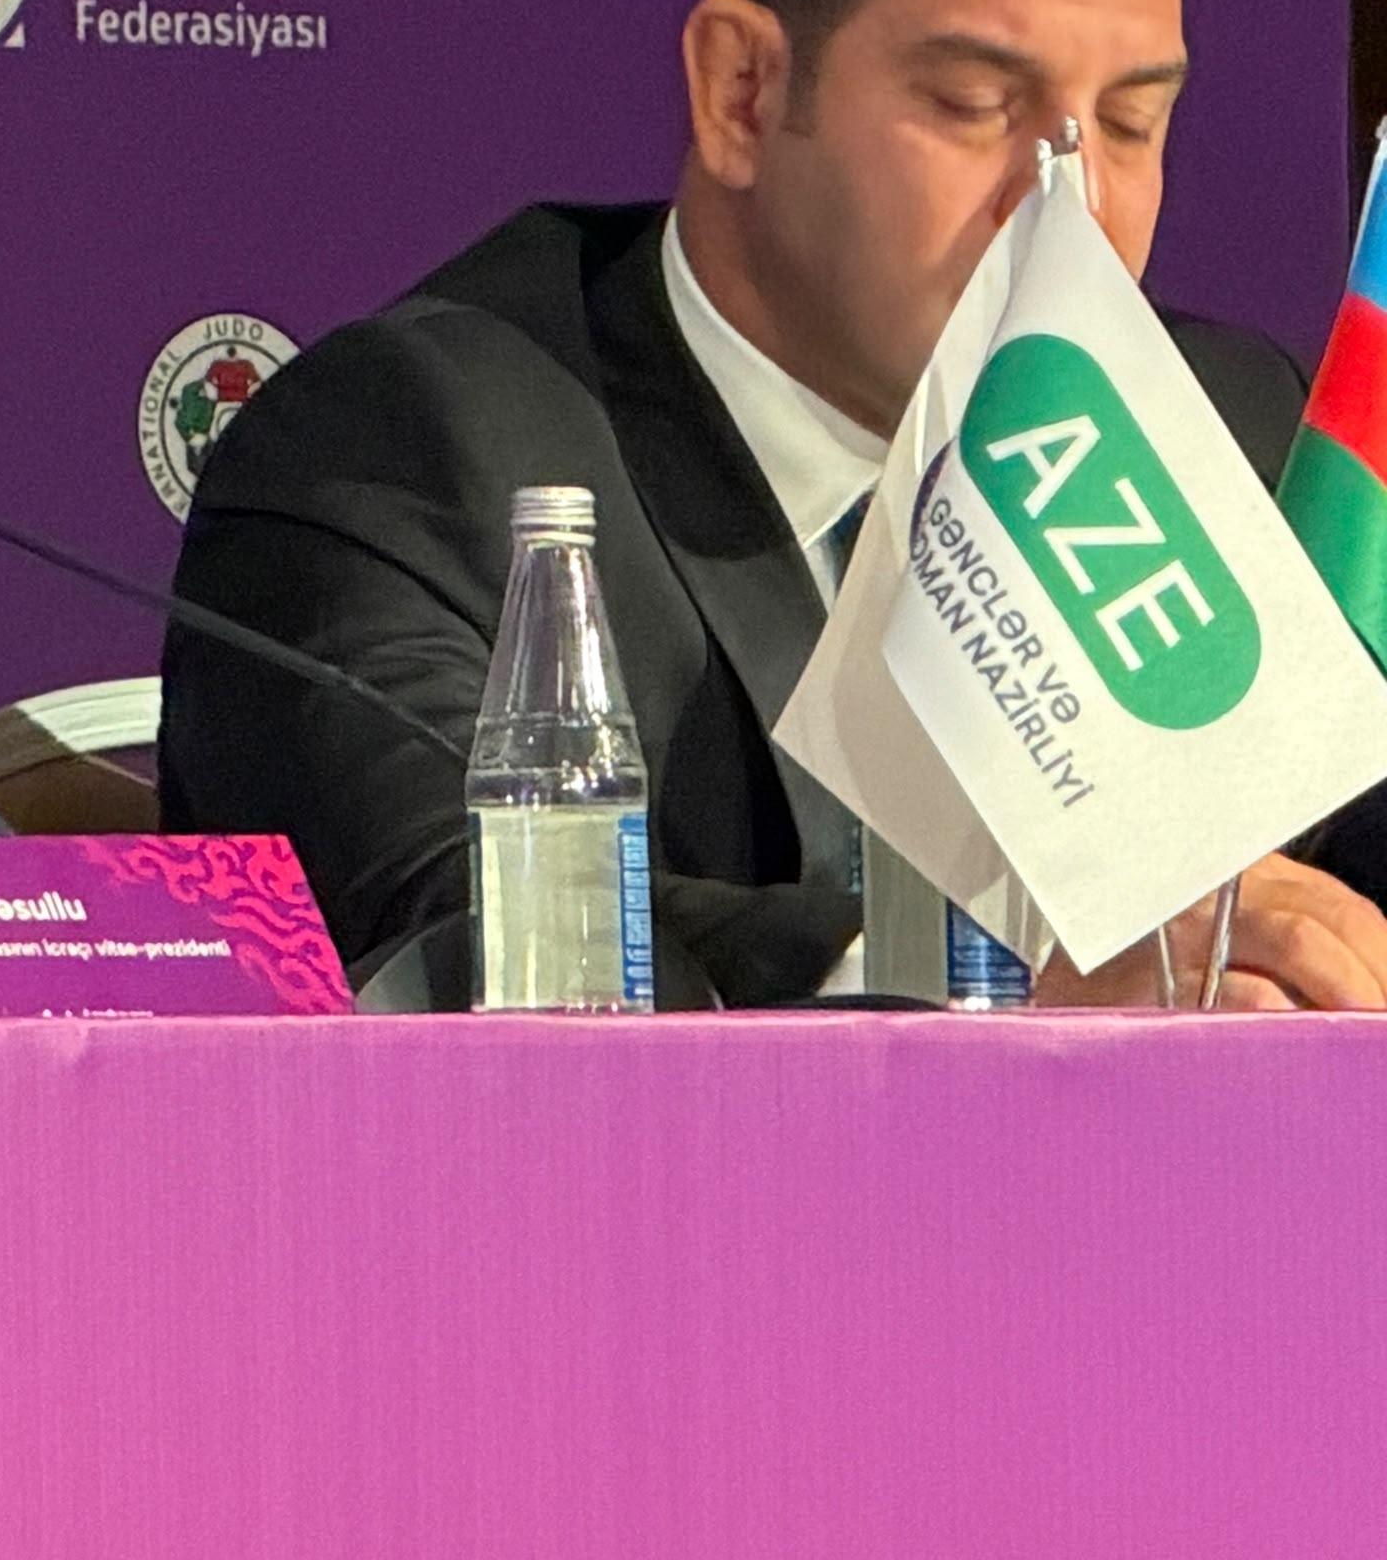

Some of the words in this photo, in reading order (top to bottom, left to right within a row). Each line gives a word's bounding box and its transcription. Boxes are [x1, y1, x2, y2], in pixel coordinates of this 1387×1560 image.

[203, 319, 264, 341] JUDO
[929, 497, 1045, 669] GƏNCLƏR
[1036, 663, 1082, 724] VƏ
[987, 414, 1216, 672] AZE
[909, 529, 977, 635] DMAN
[960, 630, 1096, 809] NAZİRLİYİ
